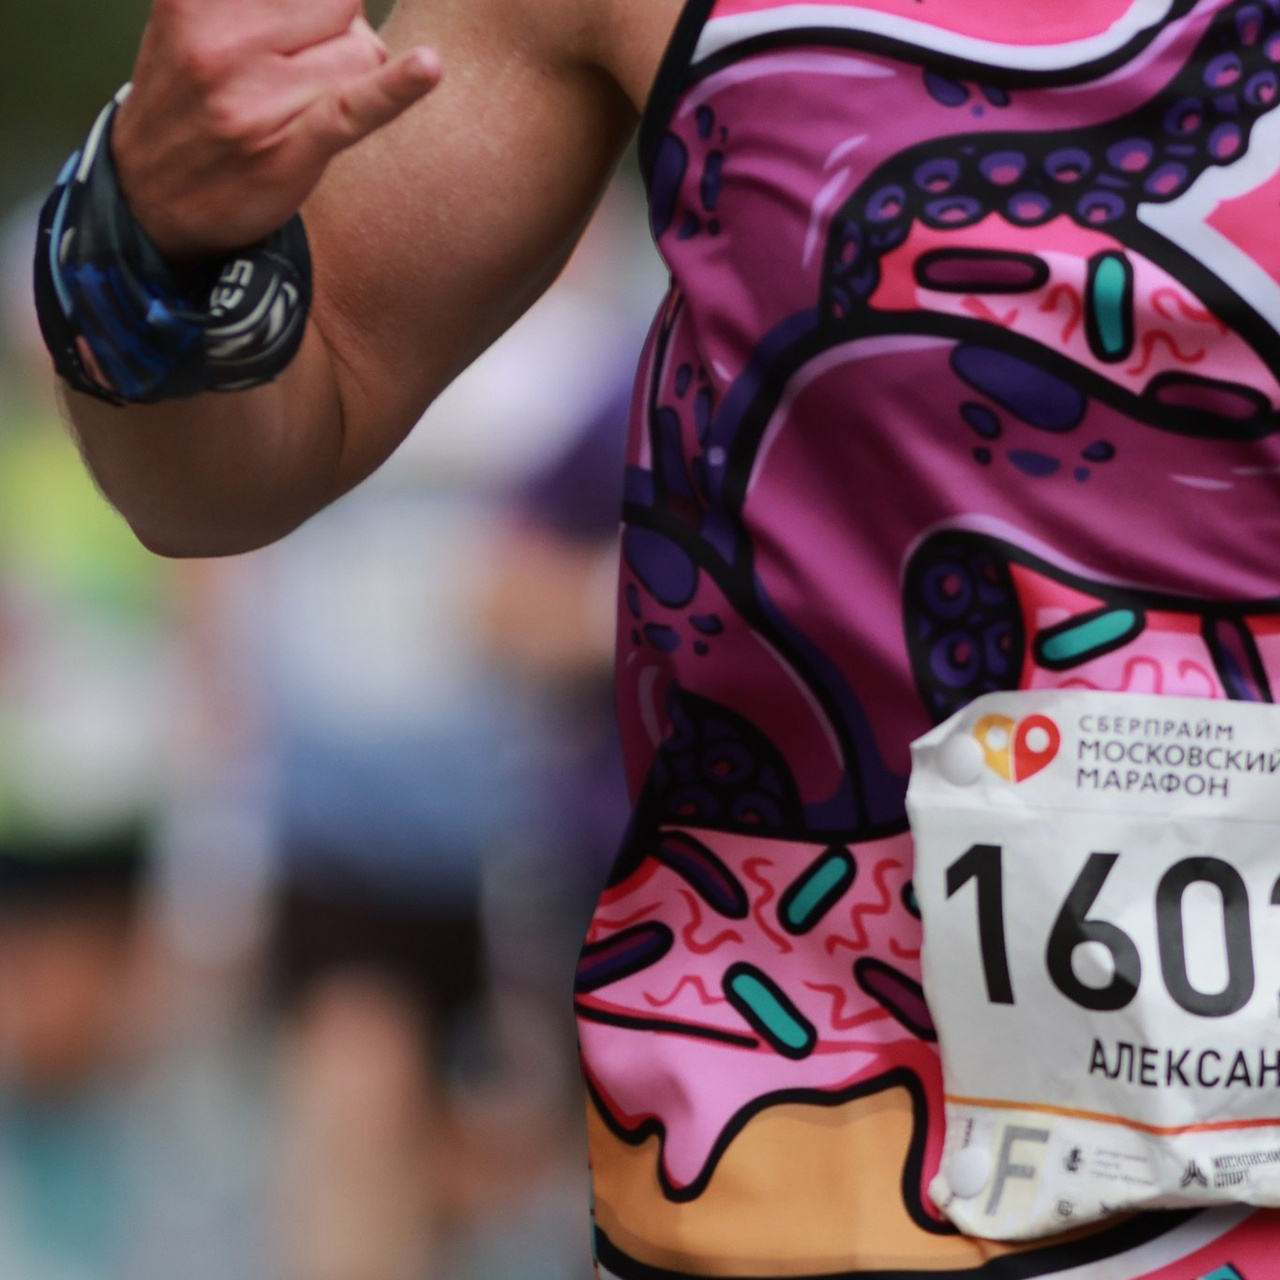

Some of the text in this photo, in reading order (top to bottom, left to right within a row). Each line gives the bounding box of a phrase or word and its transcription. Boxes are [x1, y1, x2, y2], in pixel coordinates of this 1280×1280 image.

[1078, 714, 1234, 742] СБЕРПРАЙМ
[1075, 767, 1230, 798] МАРАФОН
[984, 1123, 1051, 1218] F
